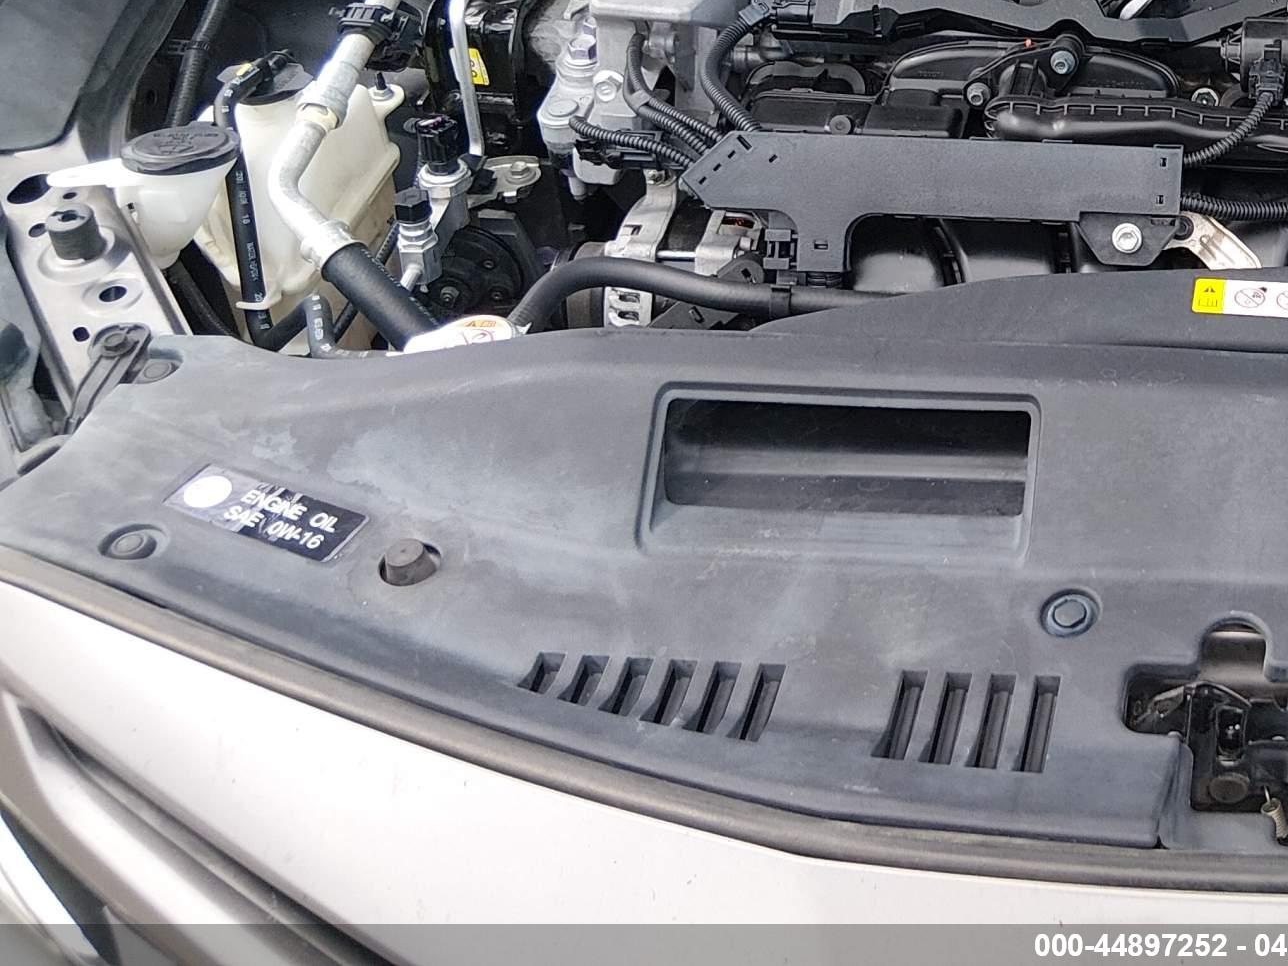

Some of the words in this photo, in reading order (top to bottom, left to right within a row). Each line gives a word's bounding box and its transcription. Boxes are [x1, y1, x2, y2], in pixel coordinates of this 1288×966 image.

[223, 505, 265, 528] SAE
[267, 520, 325, 549] 0W-16
[240, 489, 308, 521] ENGINE
[309, 512, 338, 533] OIL
